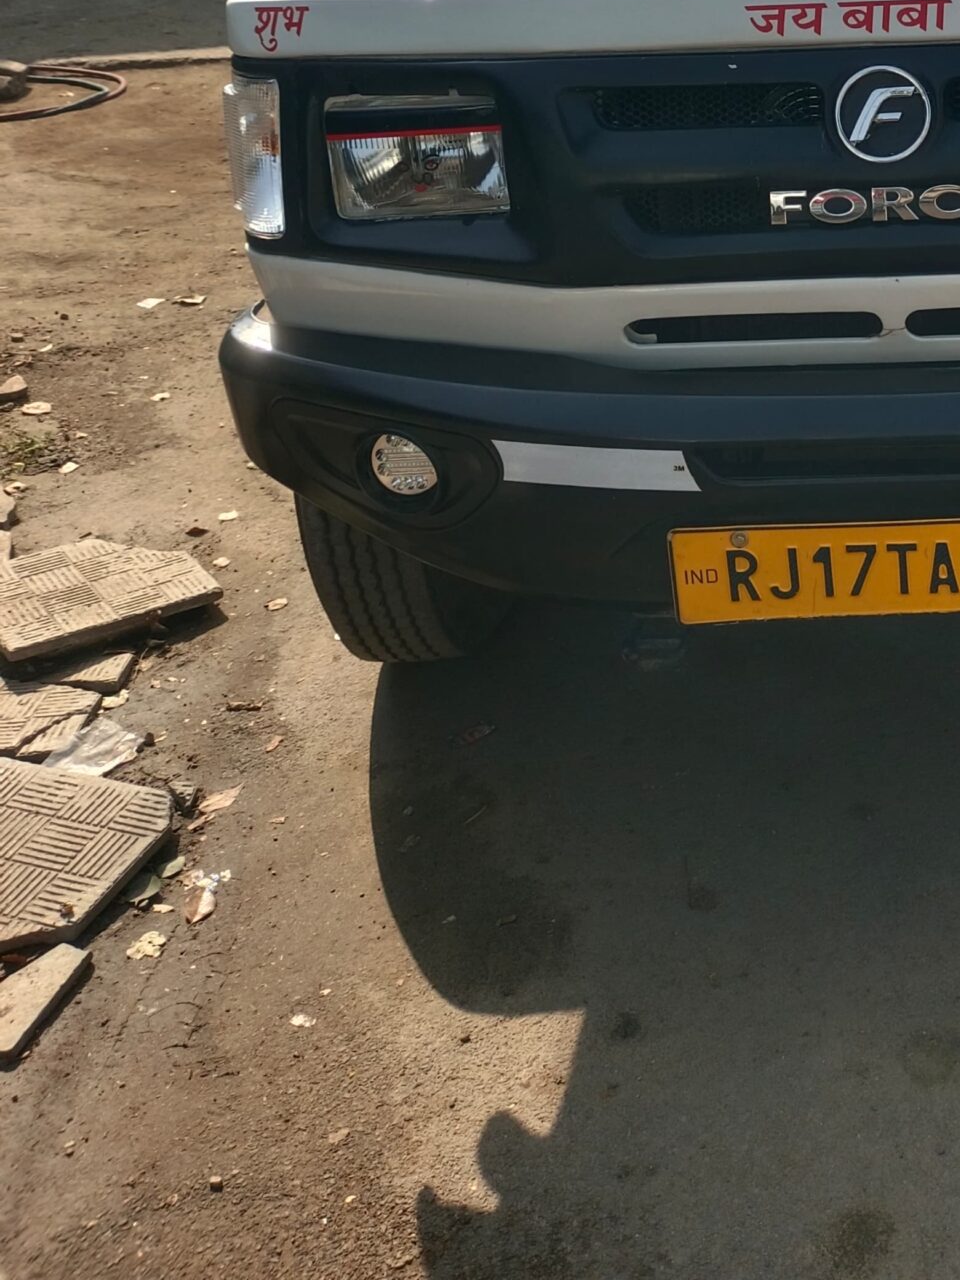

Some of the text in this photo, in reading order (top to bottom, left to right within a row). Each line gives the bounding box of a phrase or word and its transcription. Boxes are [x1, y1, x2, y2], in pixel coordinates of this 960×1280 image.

[254, 6, 310, 52] शुभ
[744, 2, 828, 37] जय
[683, 568, 719, 586] IND
